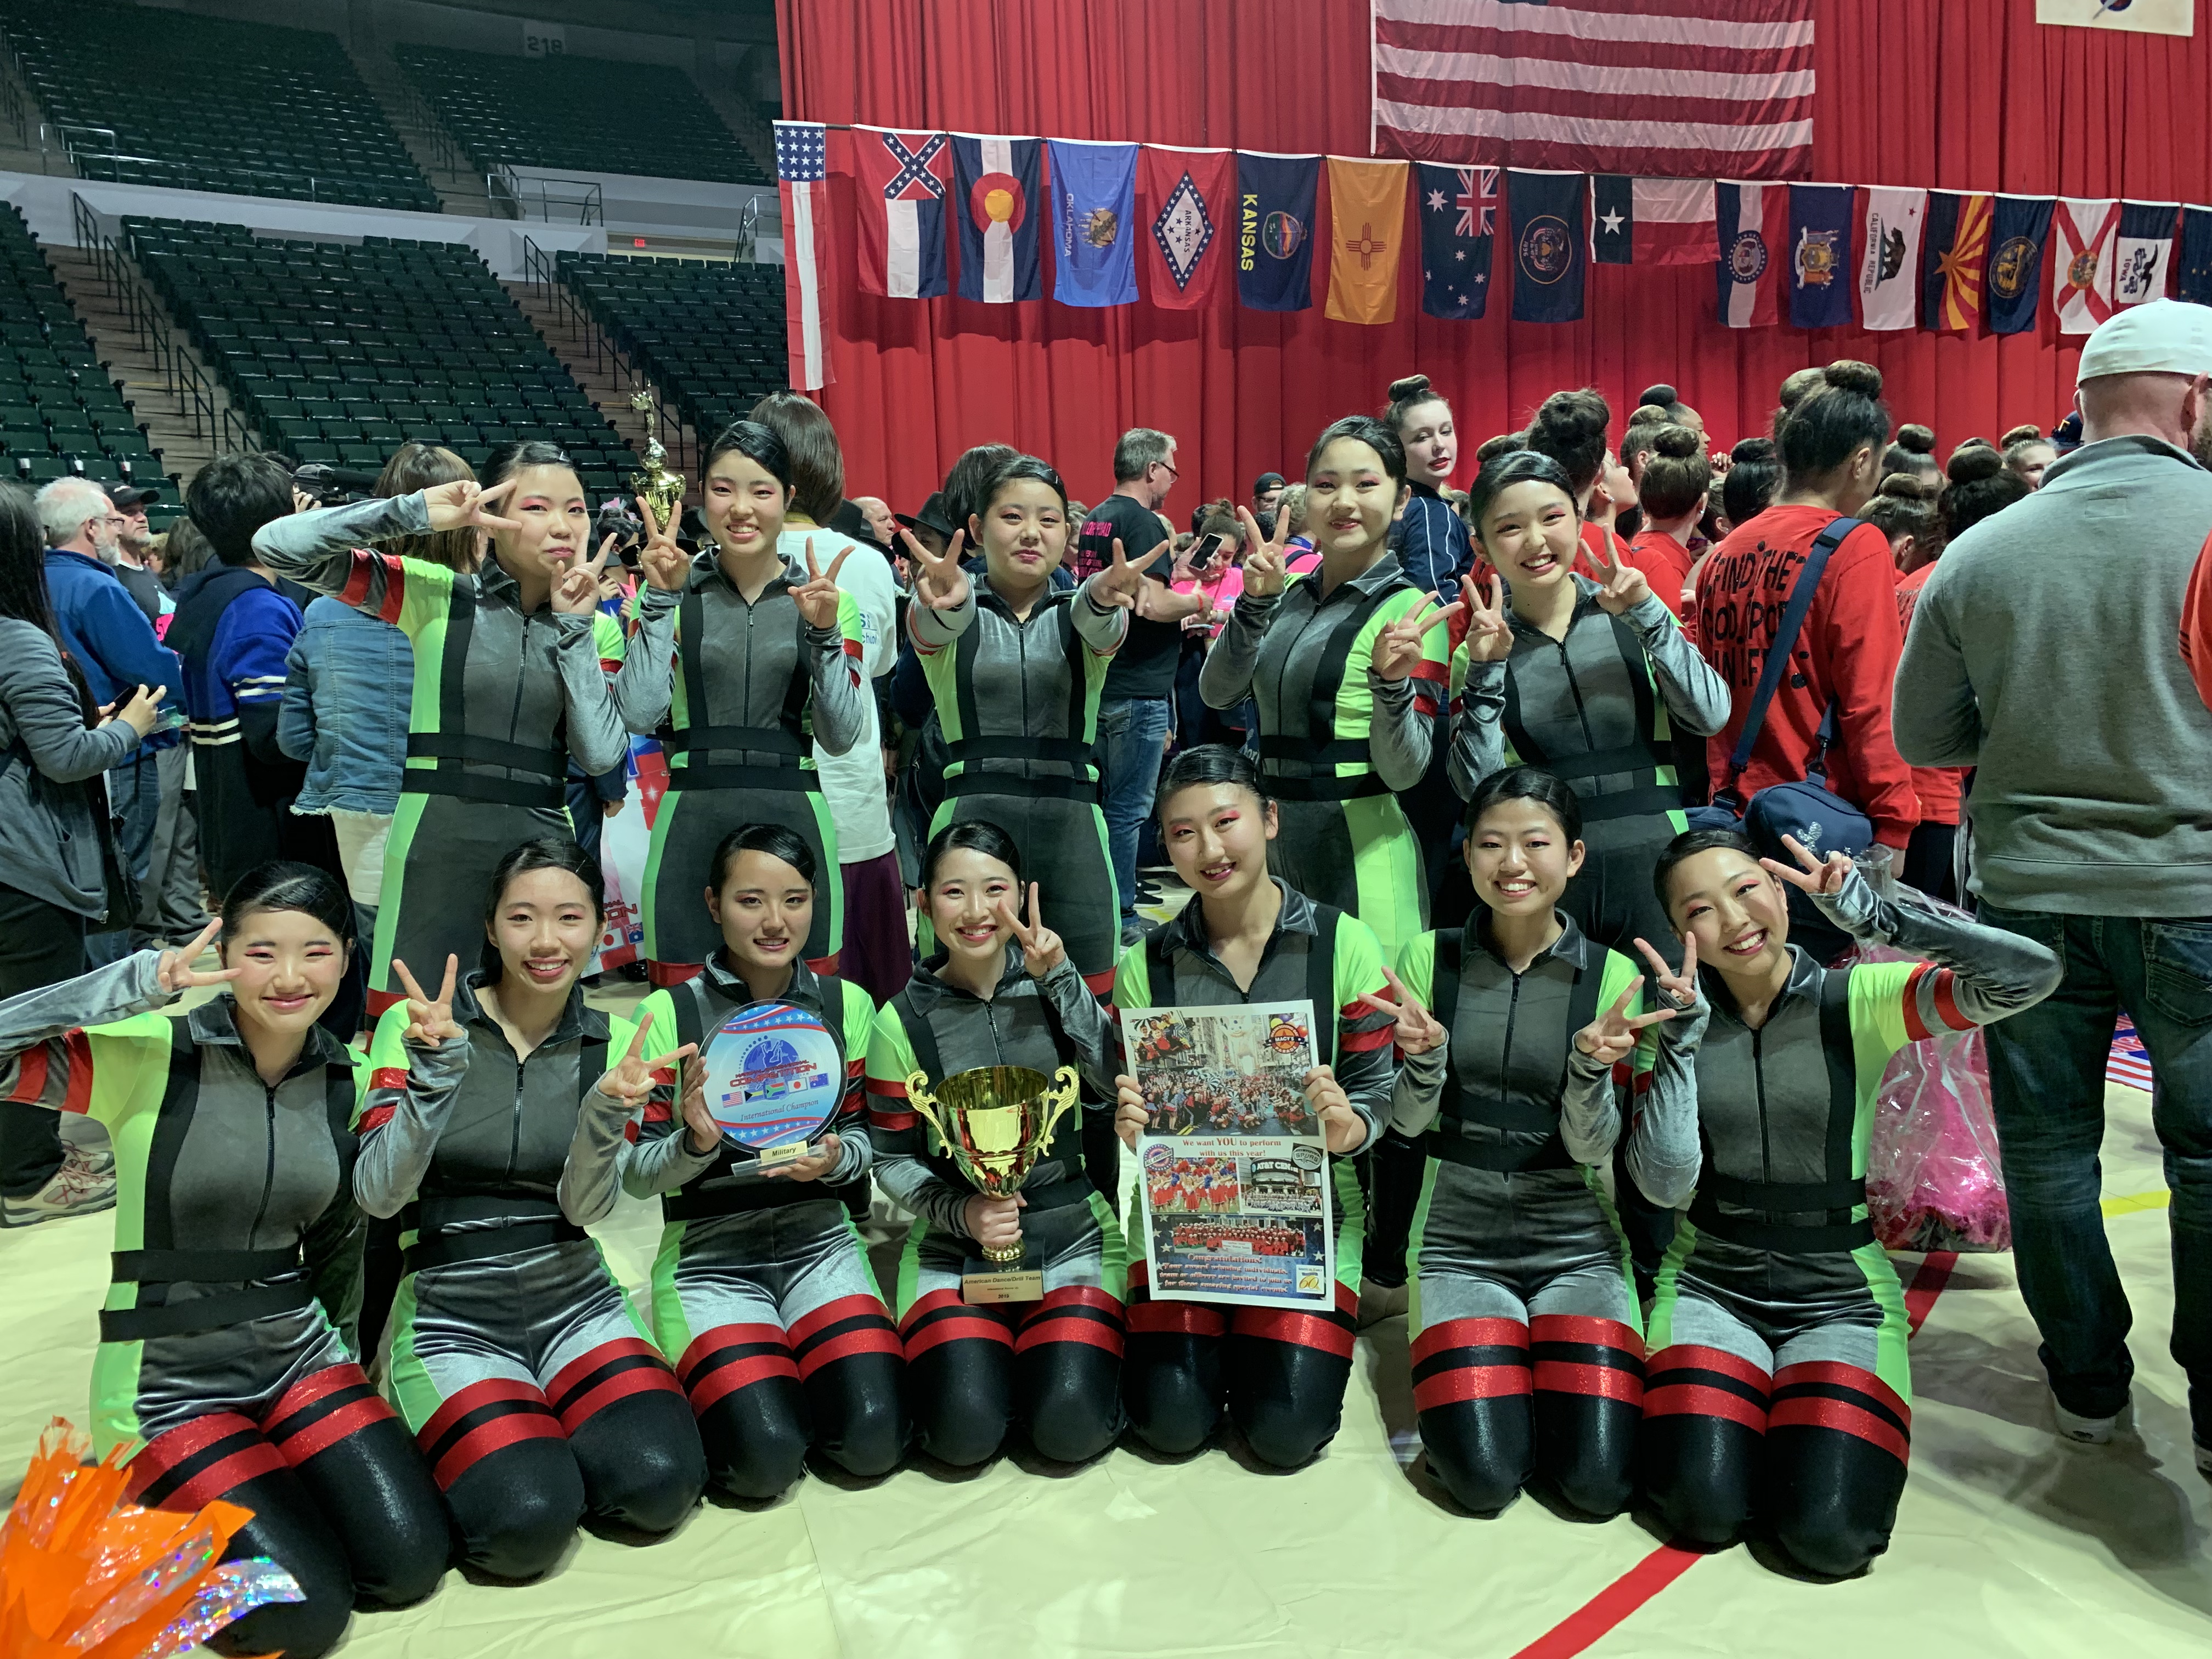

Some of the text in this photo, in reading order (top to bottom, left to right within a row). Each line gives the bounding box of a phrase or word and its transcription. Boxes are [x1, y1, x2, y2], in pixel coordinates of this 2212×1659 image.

[527, 36, 562, 53] 218
[1064, 193, 1074, 257] OKLAHOMA
[1183, 210, 1192, 253] ARKANSAS
[1240, 194, 1258, 271] KANSAS
[1863, 212, 1879, 294] CALIFORNIA REPUBLIC
[2119, 258, 2132, 281] IOWA
[729, 1062, 817, 1088] COMPETITION
[740, 1099, 819, 1121] International Champion
[772, 1147, 797, 1157] Military
[1216, 1137, 1237, 1146] YOU
[1257, 1161, 1274, 1170] AT&T
[1295, 1152, 1319, 1163] SPURS
[1299, 1275, 1319, 1289] 60
